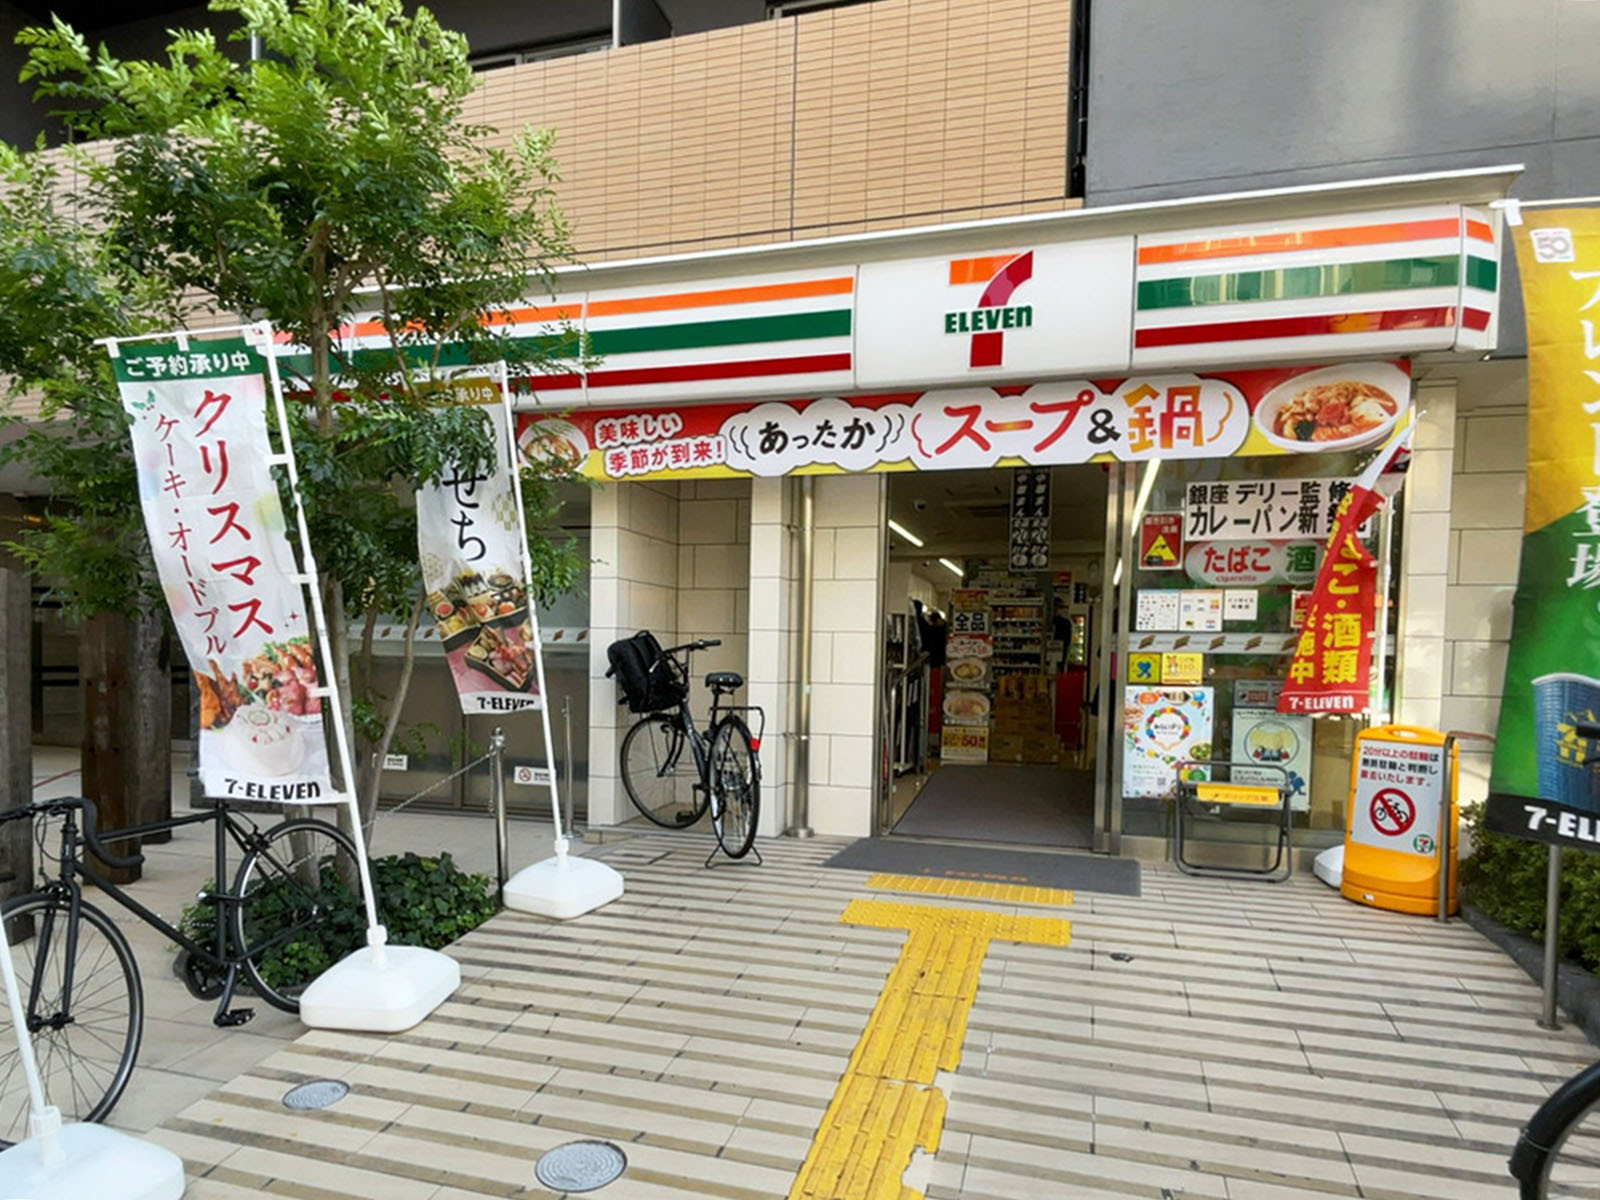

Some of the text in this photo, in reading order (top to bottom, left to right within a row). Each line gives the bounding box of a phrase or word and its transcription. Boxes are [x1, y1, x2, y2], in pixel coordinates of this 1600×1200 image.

[125, 350, 251, 377] ご予約承り中
[598, 417, 680, 445] 美味しい
[758, 383, 1206, 455] あったか スープ&鍋
[609, 440, 723, 472] 季節が到来!
[193, 389, 274, 639] クリスマス
[1189, 503, 1367, 536] カレーパン新
[155, 414, 227, 656] ケーキ・オードブル
[1203, 545, 1272, 573] たばこ
[1285, 545, 1318, 573] 酒
[955, 612, 985, 632] 全品
[1523, 804, 1600, 842] 7-EL
